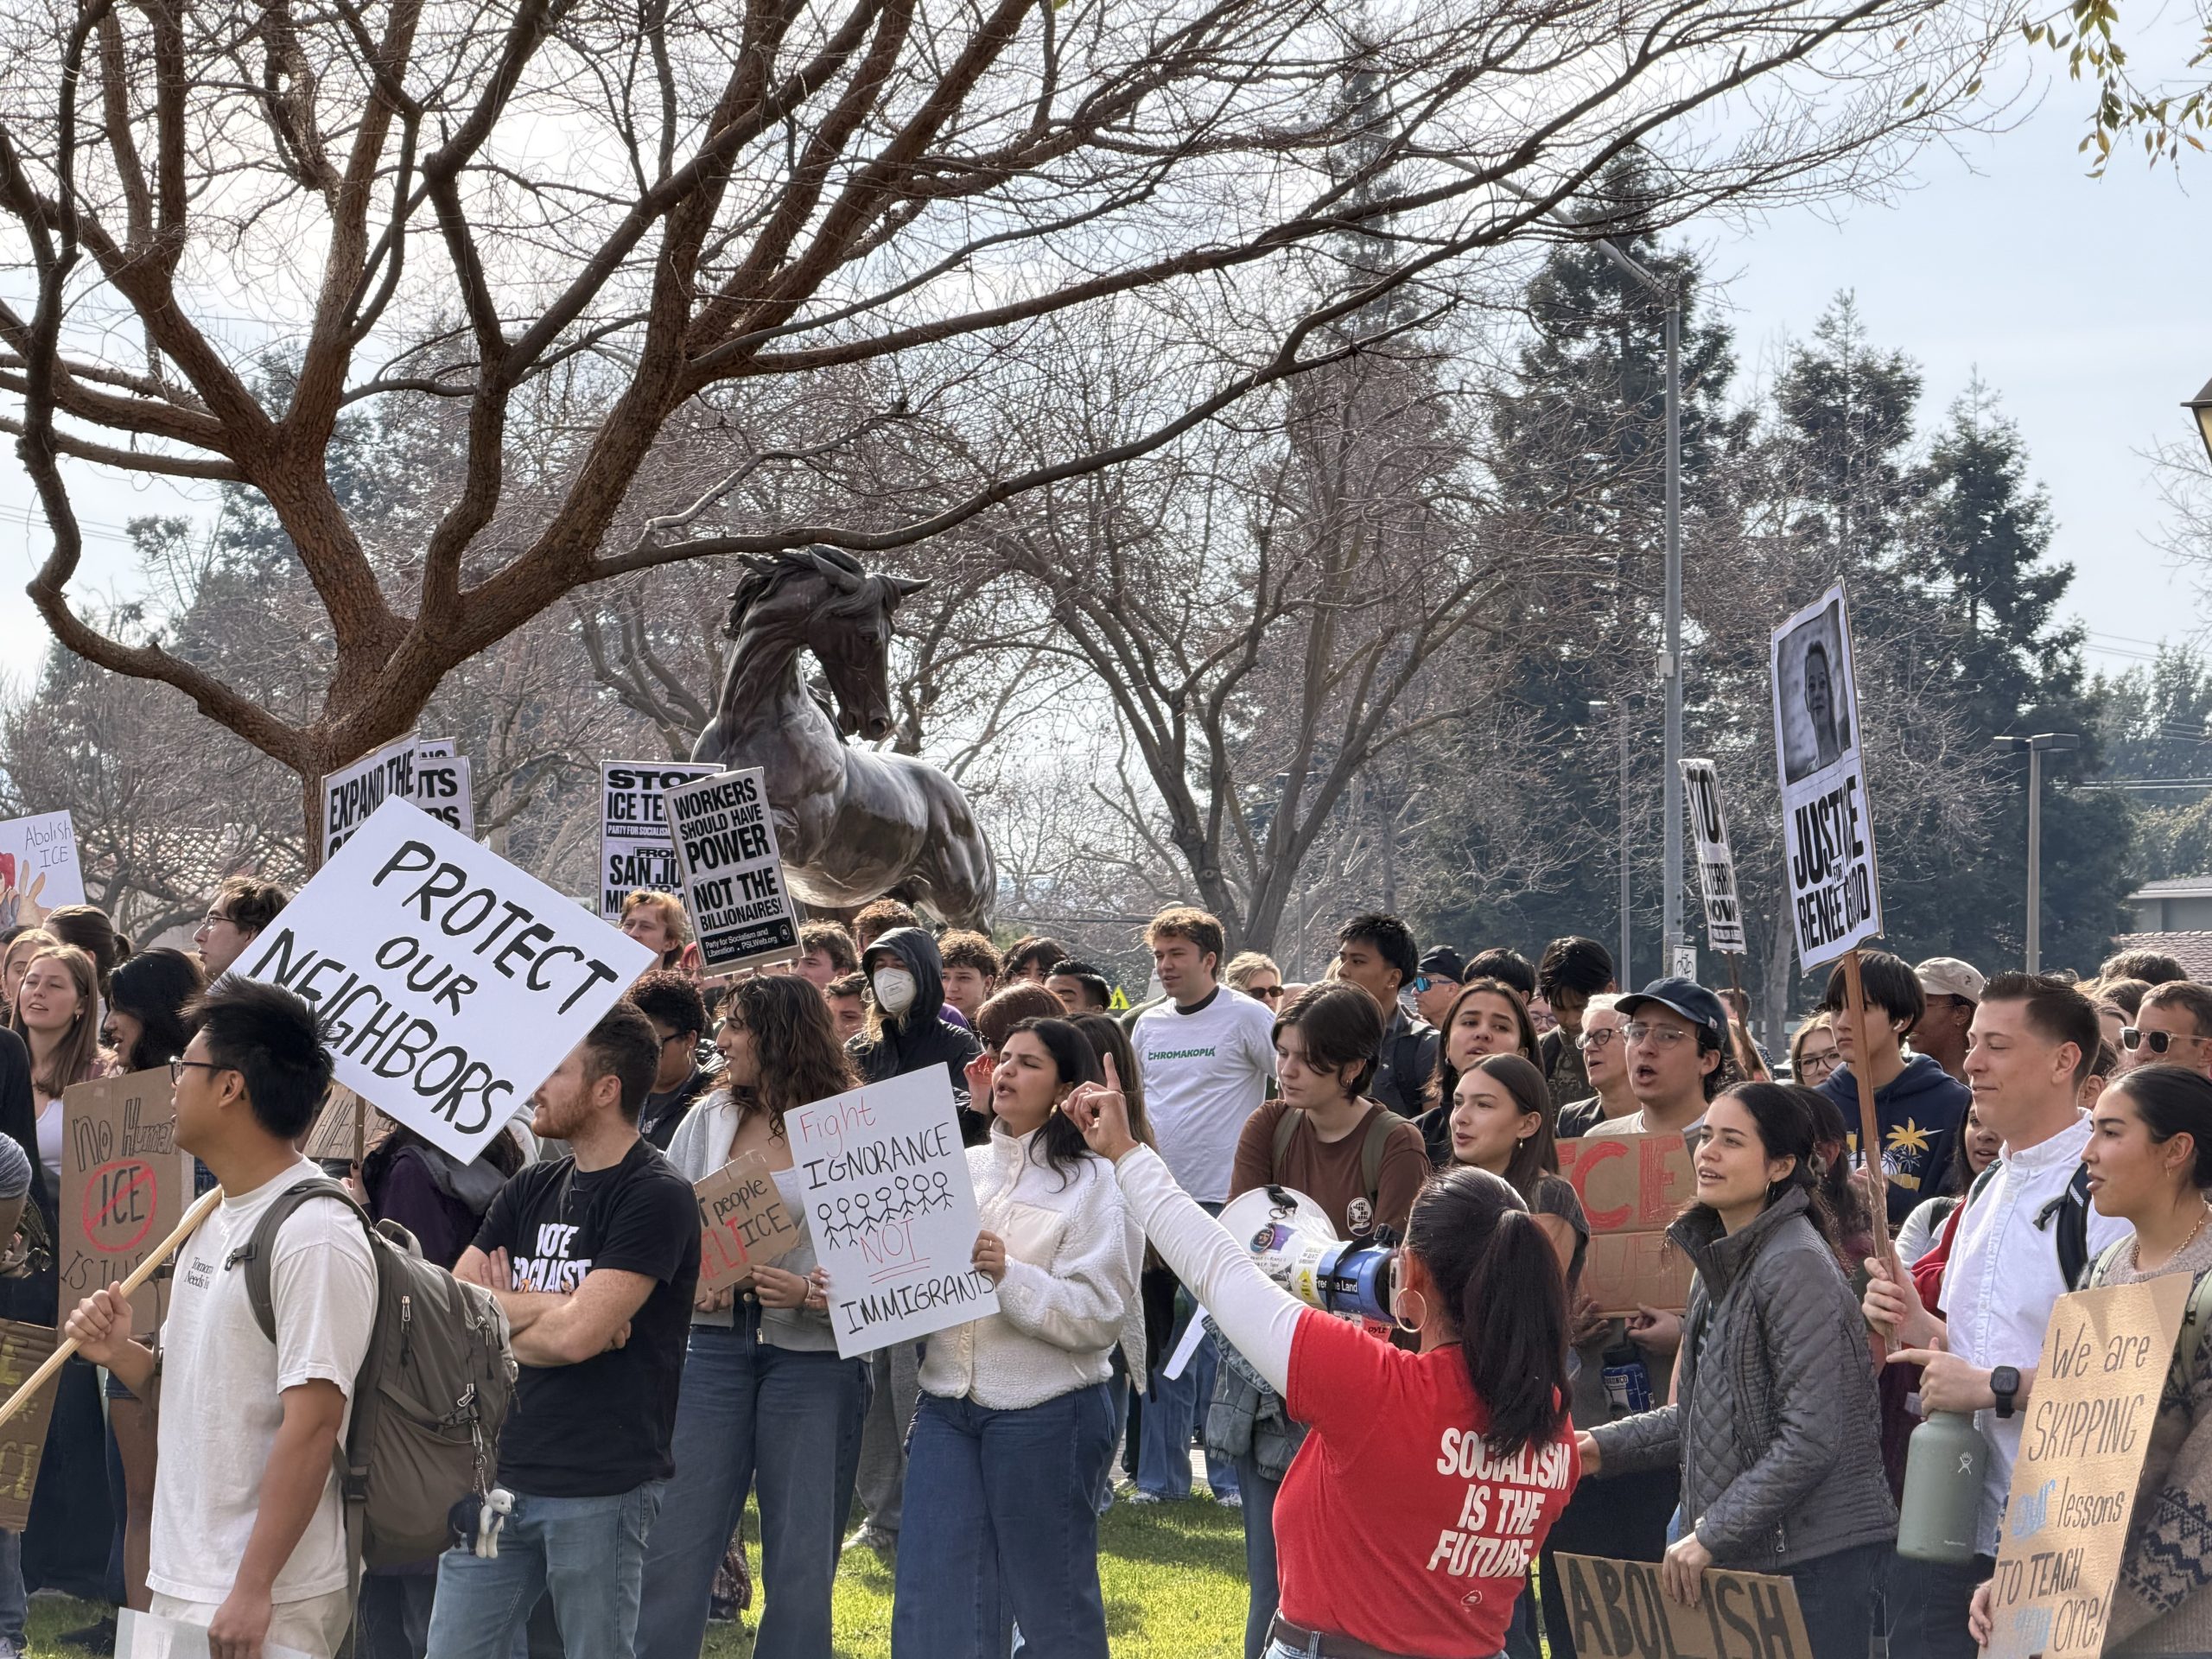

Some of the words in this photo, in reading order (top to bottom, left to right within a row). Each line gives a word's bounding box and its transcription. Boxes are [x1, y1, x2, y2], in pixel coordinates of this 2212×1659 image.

[329, 764, 385, 835] EXPAND
[387, 749, 414, 798] THE
[607, 770, 715, 790] STO
[673, 778, 758, 821] WORKERS
[607, 792, 637, 820] ICE
[641, 794, 668, 821] TE
[607, 825, 626, 835] PARTY
[626, 826, 639, 835] FOR
[679, 813, 728, 841] SHOULD
[733, 804, 764, 827] HAVE
[25, 820, 72, 851] Abolish
[40, 847, 69, 868] ICE
[684, 823, 771, 874] POWER
[1793, 775, 1864, 890] JUSTICE
[609, 855, 650, 886] SAN
[693, 877, 734, 913] NOT
[736, 867, 779, 901] THE
[1833, 861, 1844, 885] FOR
[372, 841, 620, 1015] PROTECT
[699, 898, 784, 932] BILLIONAIRES!
[705, 940, 719, 950] Party
[728, 931, 756, 944] Socialism
[756, 928, 769, 938] and
[1797, 884, 1846, 952] RENEE
[374, 936, 479, 1016] OUR
[707, 946, 735, 957] Liberation
[249, 927, 514, 1135] NEIGHBORS
[1147, 1046, 1217, 1060] CHROMAKOPIA
[121, 1097, 180, 1157] Huma
[798, 1096, 876, 1159] Fight
[803, 1122, 951, 1190] IGNORANCE
[99, 1166, 145, 1228] ICE
[712, 1180, 768, 1225] people
[1557, 1135, 1684, 1231] CE
[737, 1203, 792, 1248] ICE
[859, 1218, 915, 1263] NOT
[840, 1269, 995, 1335] IMMIGRANTS
[1341, 1280, 1357, 1293] Land
[2051, 1323, 2091, 1379] We
[2104, 1333, 2151, 1373] are
[2028, 1394, 2145, 1461] SKIPPING
[1437, 1427, 1570, 1491] SOCIALISM
[1457, 1484, 1491, 1531] IS
[1495, 1488, 1546, 1535] THE
[2057, 1477, 2126, 1529] lessons
[1426, 1529, 1534, 1578] FUTURE
[1996, 1560, 2024, 1607] TO
[2028, 1548, 2084, 1599] TEACH
[1567, 1557, 1796, 1659] ABOLISH
